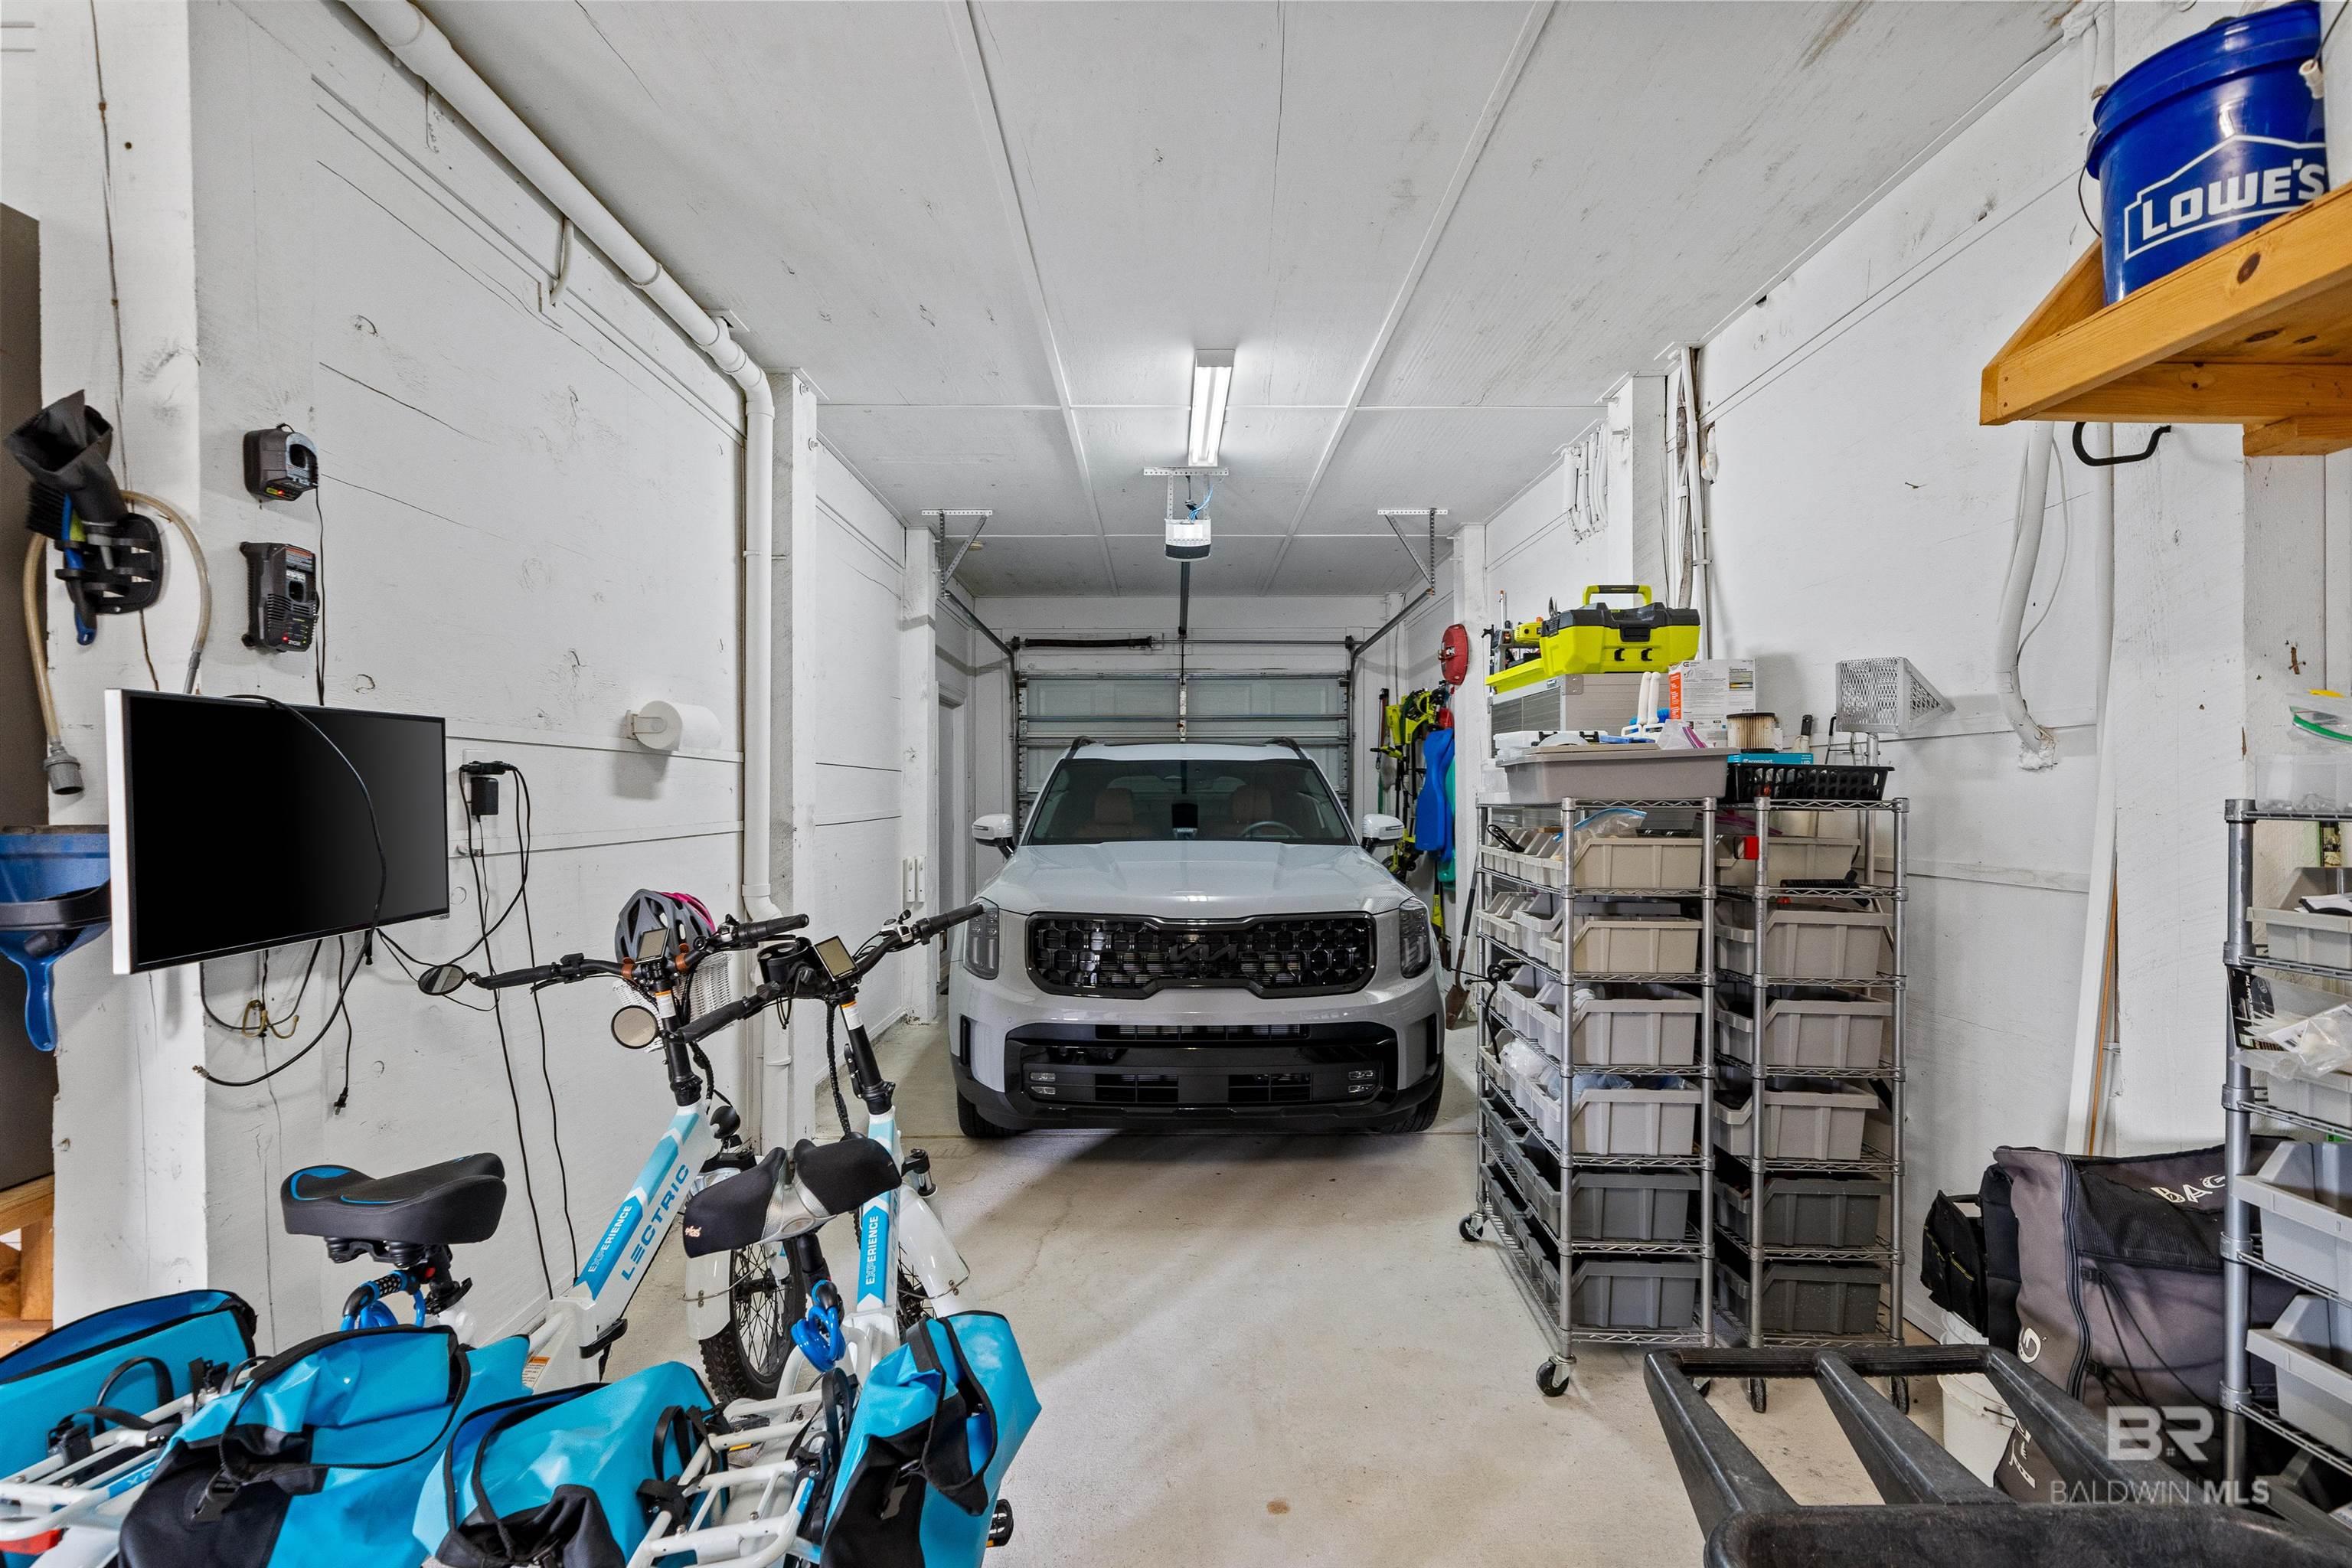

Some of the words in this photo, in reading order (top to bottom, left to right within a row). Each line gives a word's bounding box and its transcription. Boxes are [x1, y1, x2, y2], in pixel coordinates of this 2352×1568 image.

[2142, 158, 2326, 241] LOWE'S
[588, 1205, 633, 1272] EXPERIENCE
[621, 1164, 690, 1281] LECTRIC
[865, 1215, 879, 1285] EXPERIENCE
